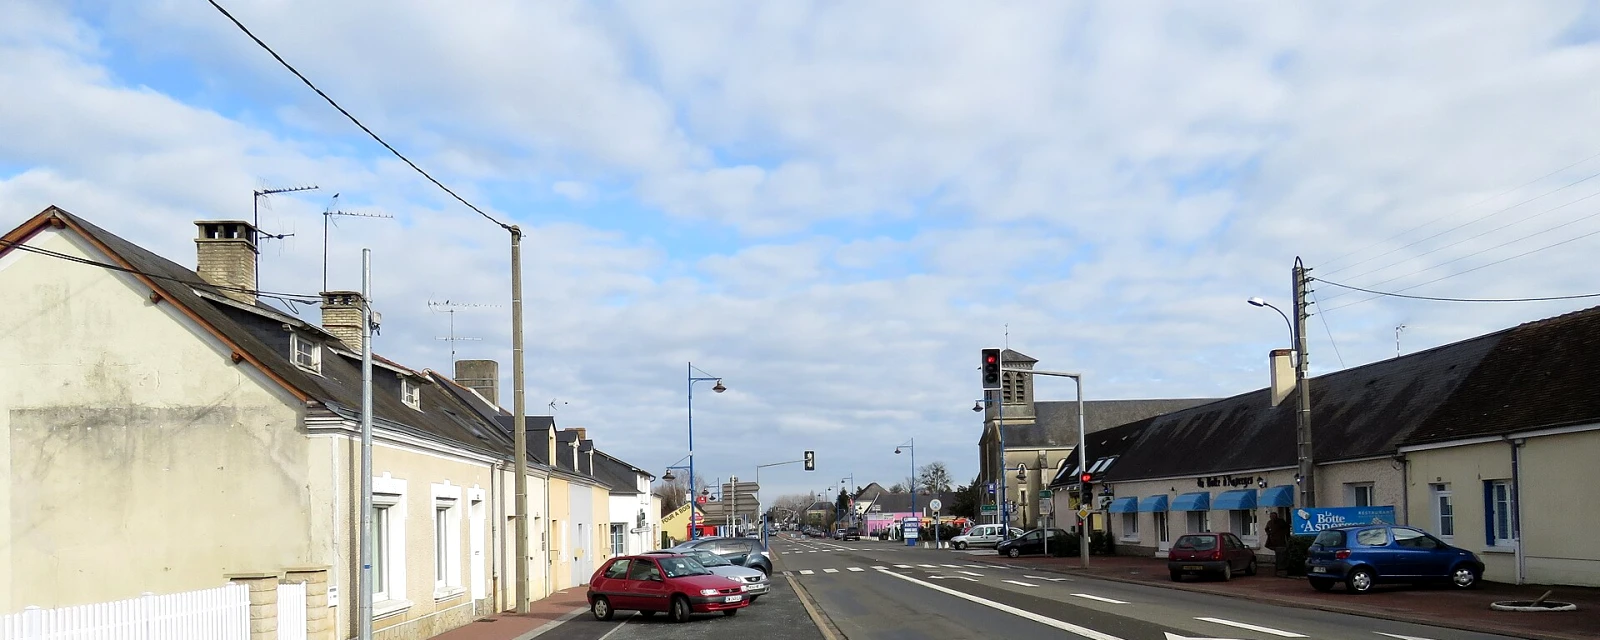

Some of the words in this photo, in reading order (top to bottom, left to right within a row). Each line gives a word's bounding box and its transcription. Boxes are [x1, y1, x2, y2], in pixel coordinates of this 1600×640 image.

[661, 514, 675, 524] FOUR
[679, 504, 690, 513] BOIS
[1317, 513, 1345, 524] Botte
